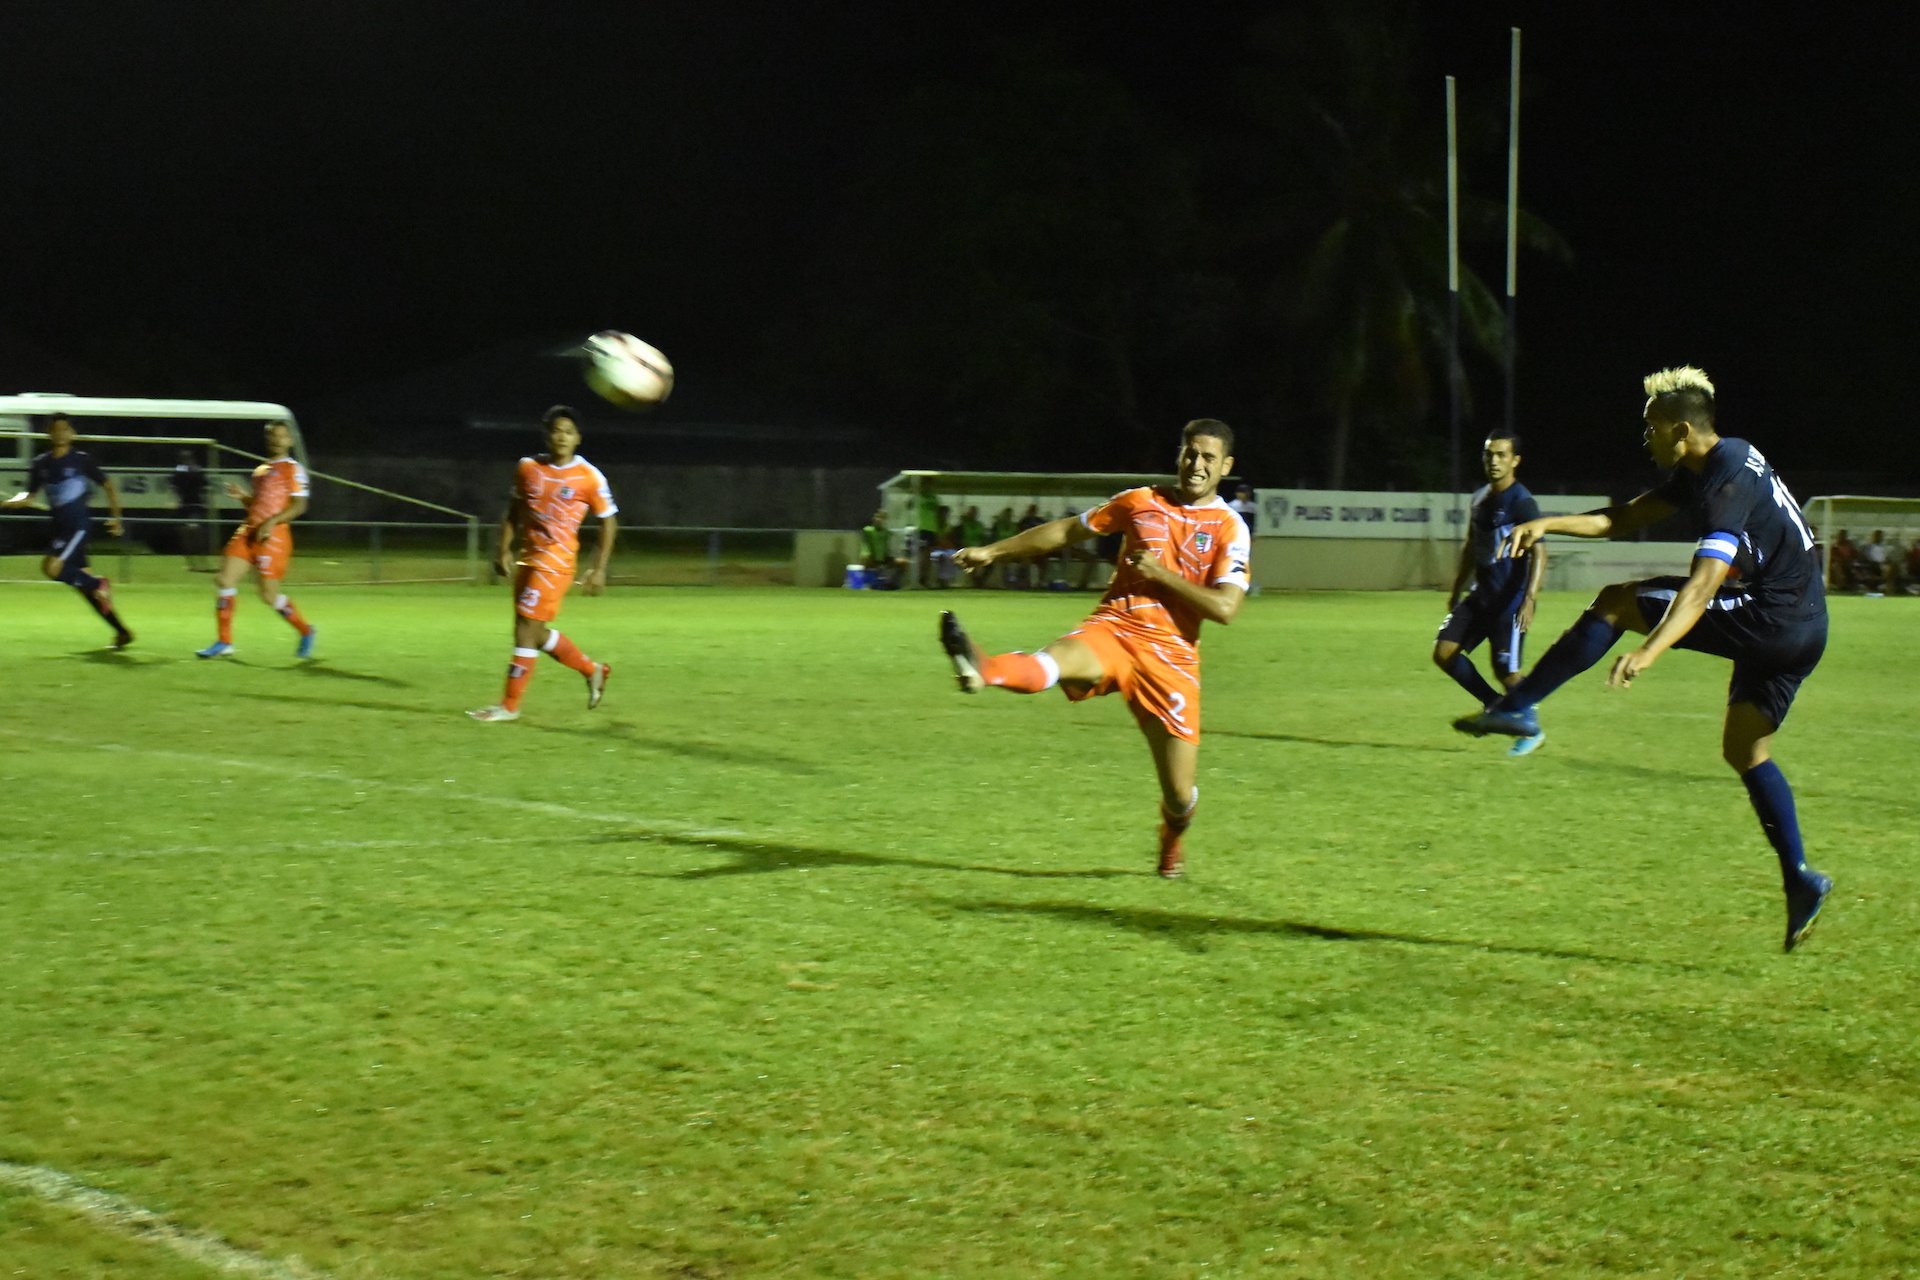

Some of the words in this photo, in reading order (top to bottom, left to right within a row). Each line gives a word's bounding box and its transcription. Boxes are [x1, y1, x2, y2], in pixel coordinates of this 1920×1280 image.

[1295, 505, 1334, 521] PLUS
[1391, 507, 1431, 523] CLUB
[1168, 692, 1186, 722] 2
